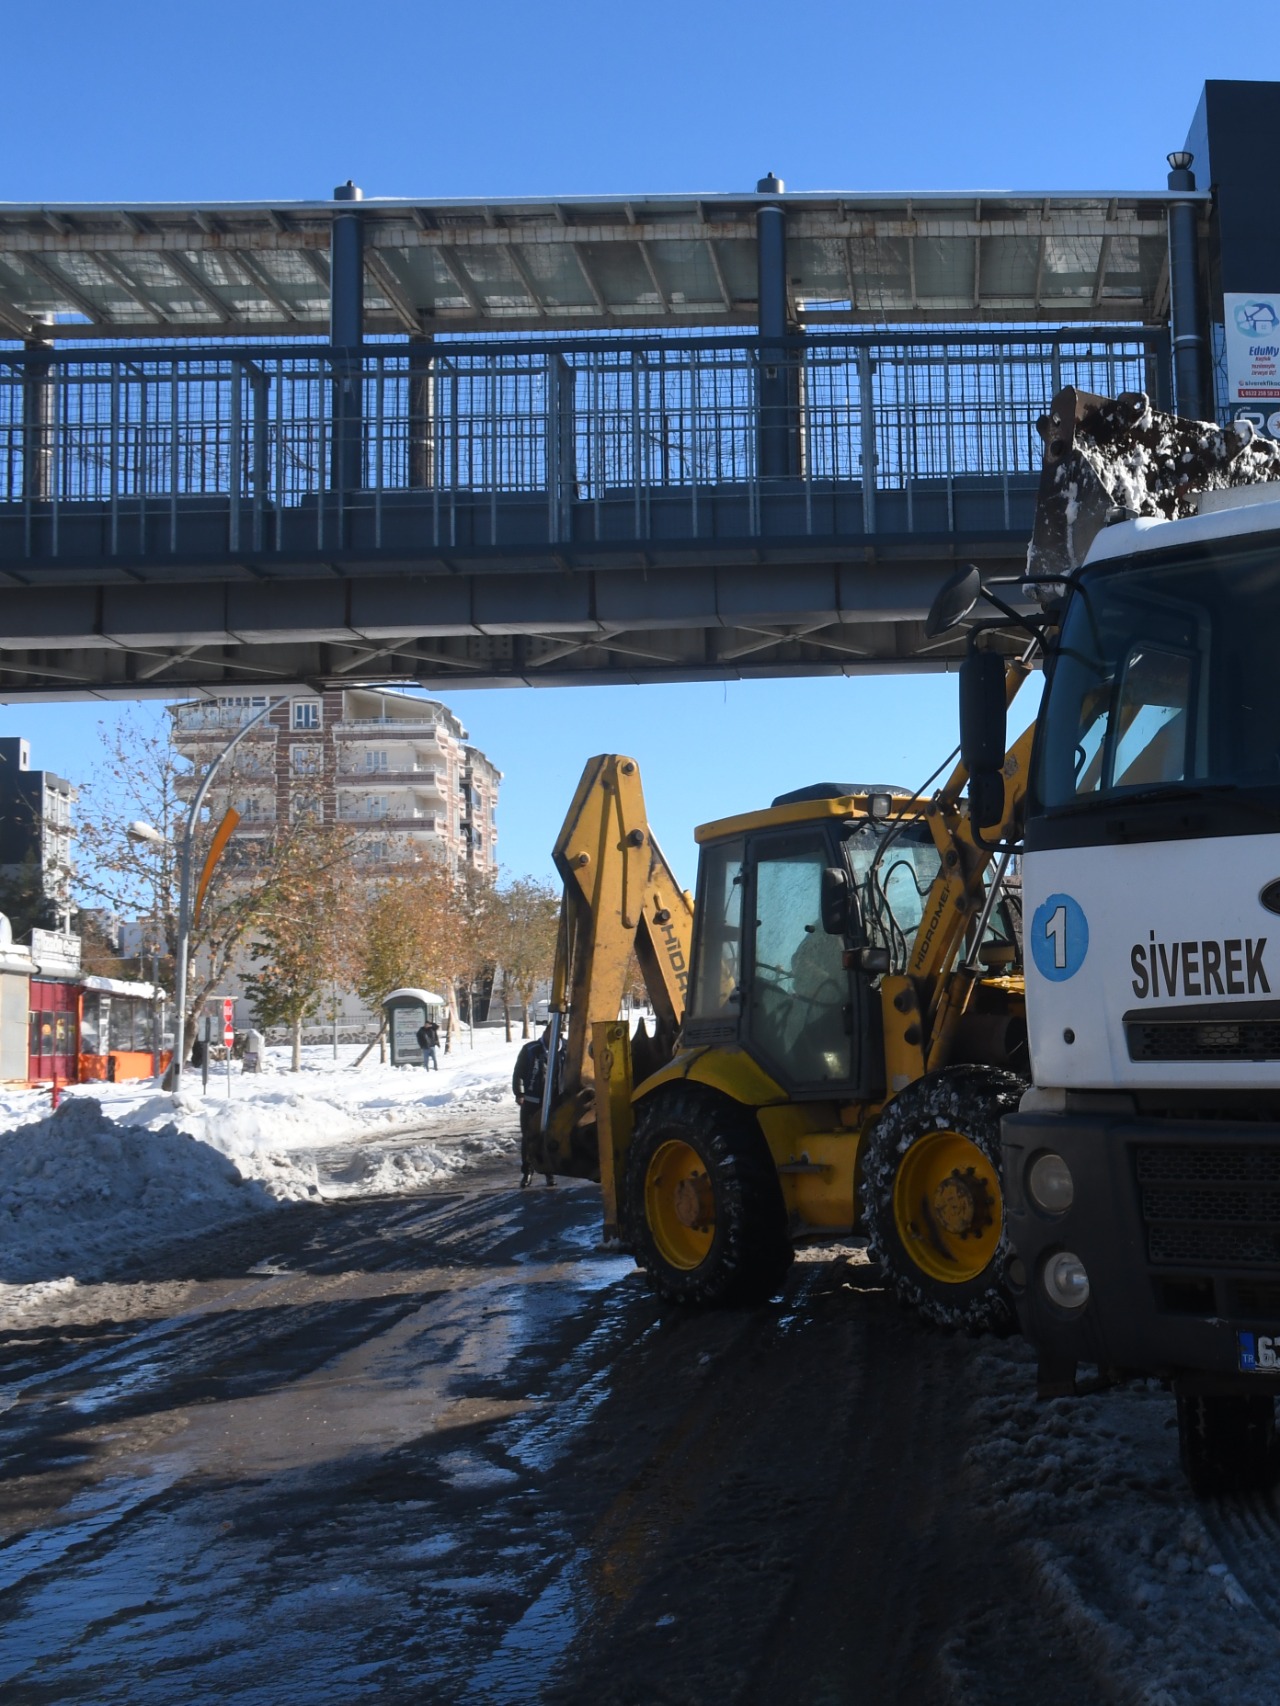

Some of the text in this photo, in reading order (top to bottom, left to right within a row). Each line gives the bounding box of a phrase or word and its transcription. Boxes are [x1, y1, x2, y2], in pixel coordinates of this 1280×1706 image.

[1249, 346, 1280, 357] EduMy
[660, 923, 689, 1004] HİDR
[1044, 905, 1067, 969] 1
[1130, 929, 1271, 999] SİVEREK
[1242, 1354, 1254, 1364] TR
